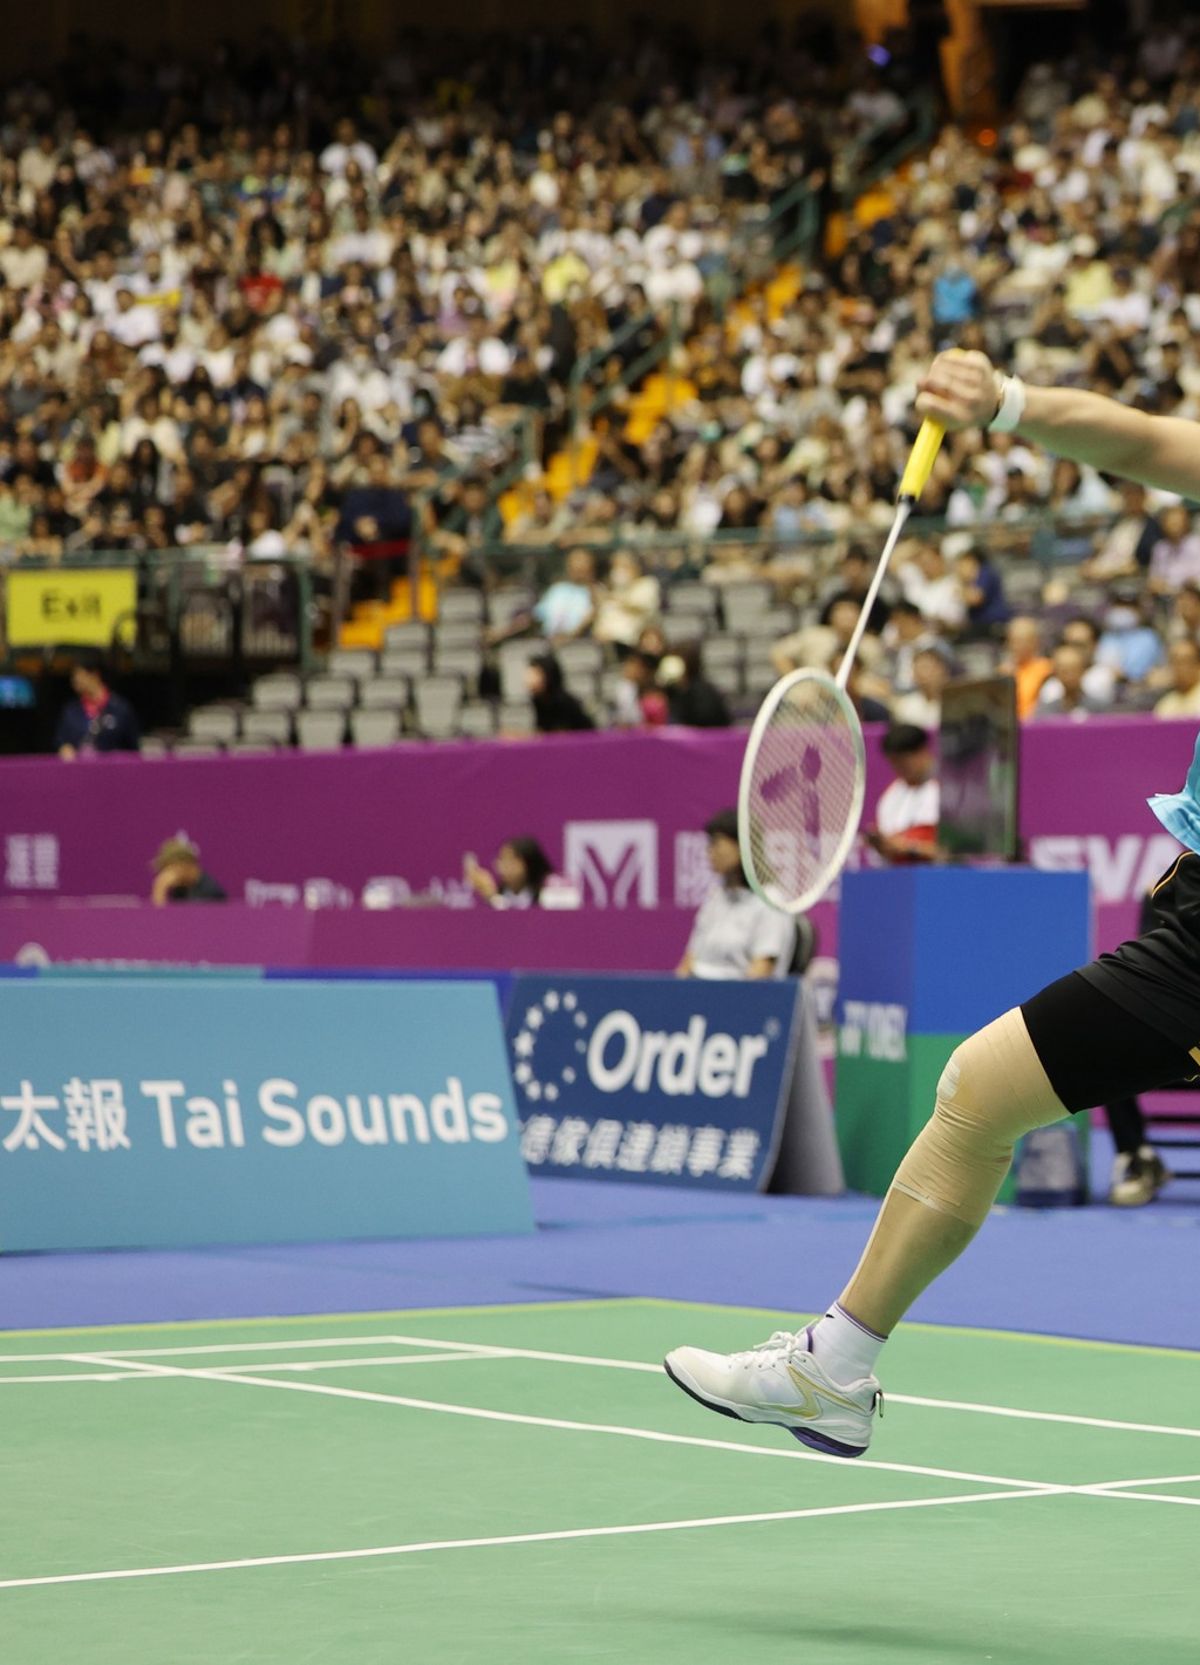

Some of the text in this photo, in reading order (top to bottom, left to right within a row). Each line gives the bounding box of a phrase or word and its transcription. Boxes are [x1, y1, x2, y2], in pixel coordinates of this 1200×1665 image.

[586, 1009, 768, 1098] Order
[2, 1077, 508, 1152] 太報 Tai Sounds
